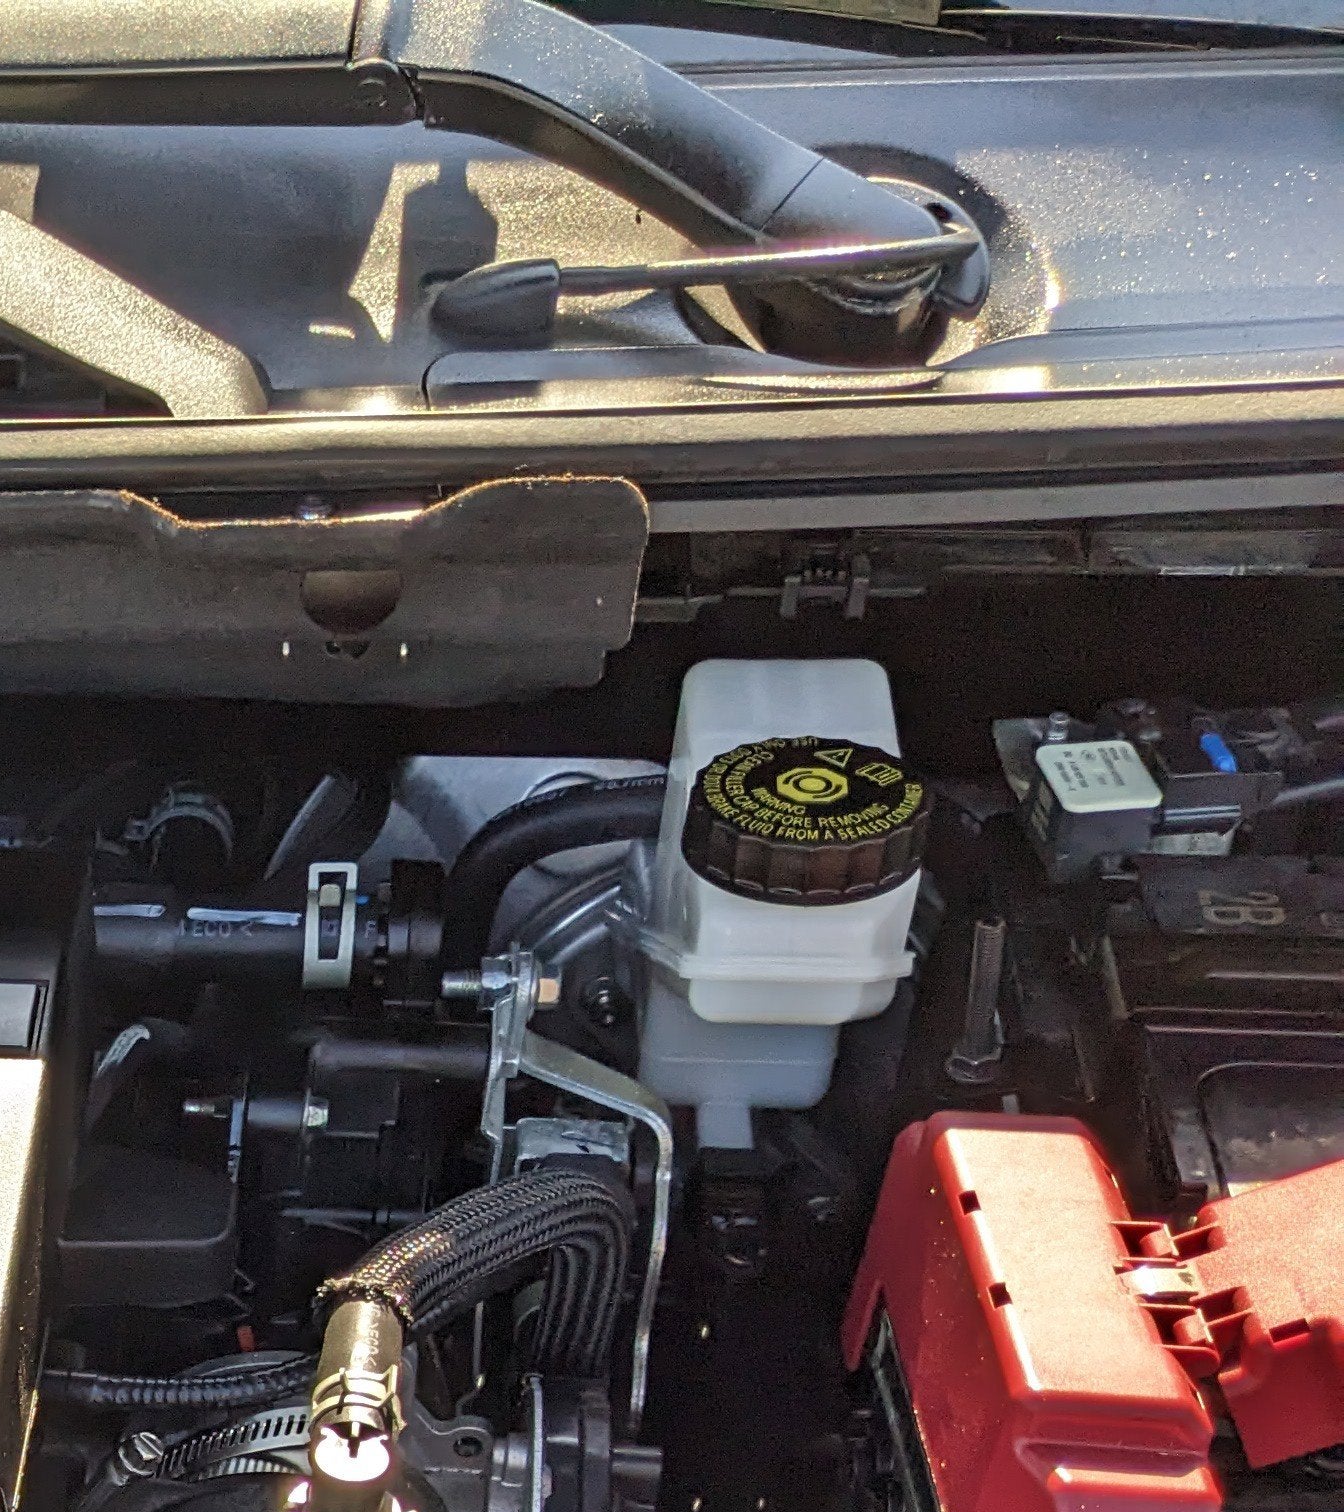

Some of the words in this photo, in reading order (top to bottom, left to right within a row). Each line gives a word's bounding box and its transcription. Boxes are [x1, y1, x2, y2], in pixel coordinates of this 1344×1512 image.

[732, 795, 760, 812] CAP
[753, 808, 812, 828] BEFORE
[735, 813, 775, 835] FLUID
[776, 827, 820, 841] FROM
[824, 829, 834, 841] A
[837, 818, 891, 841] SEALED
